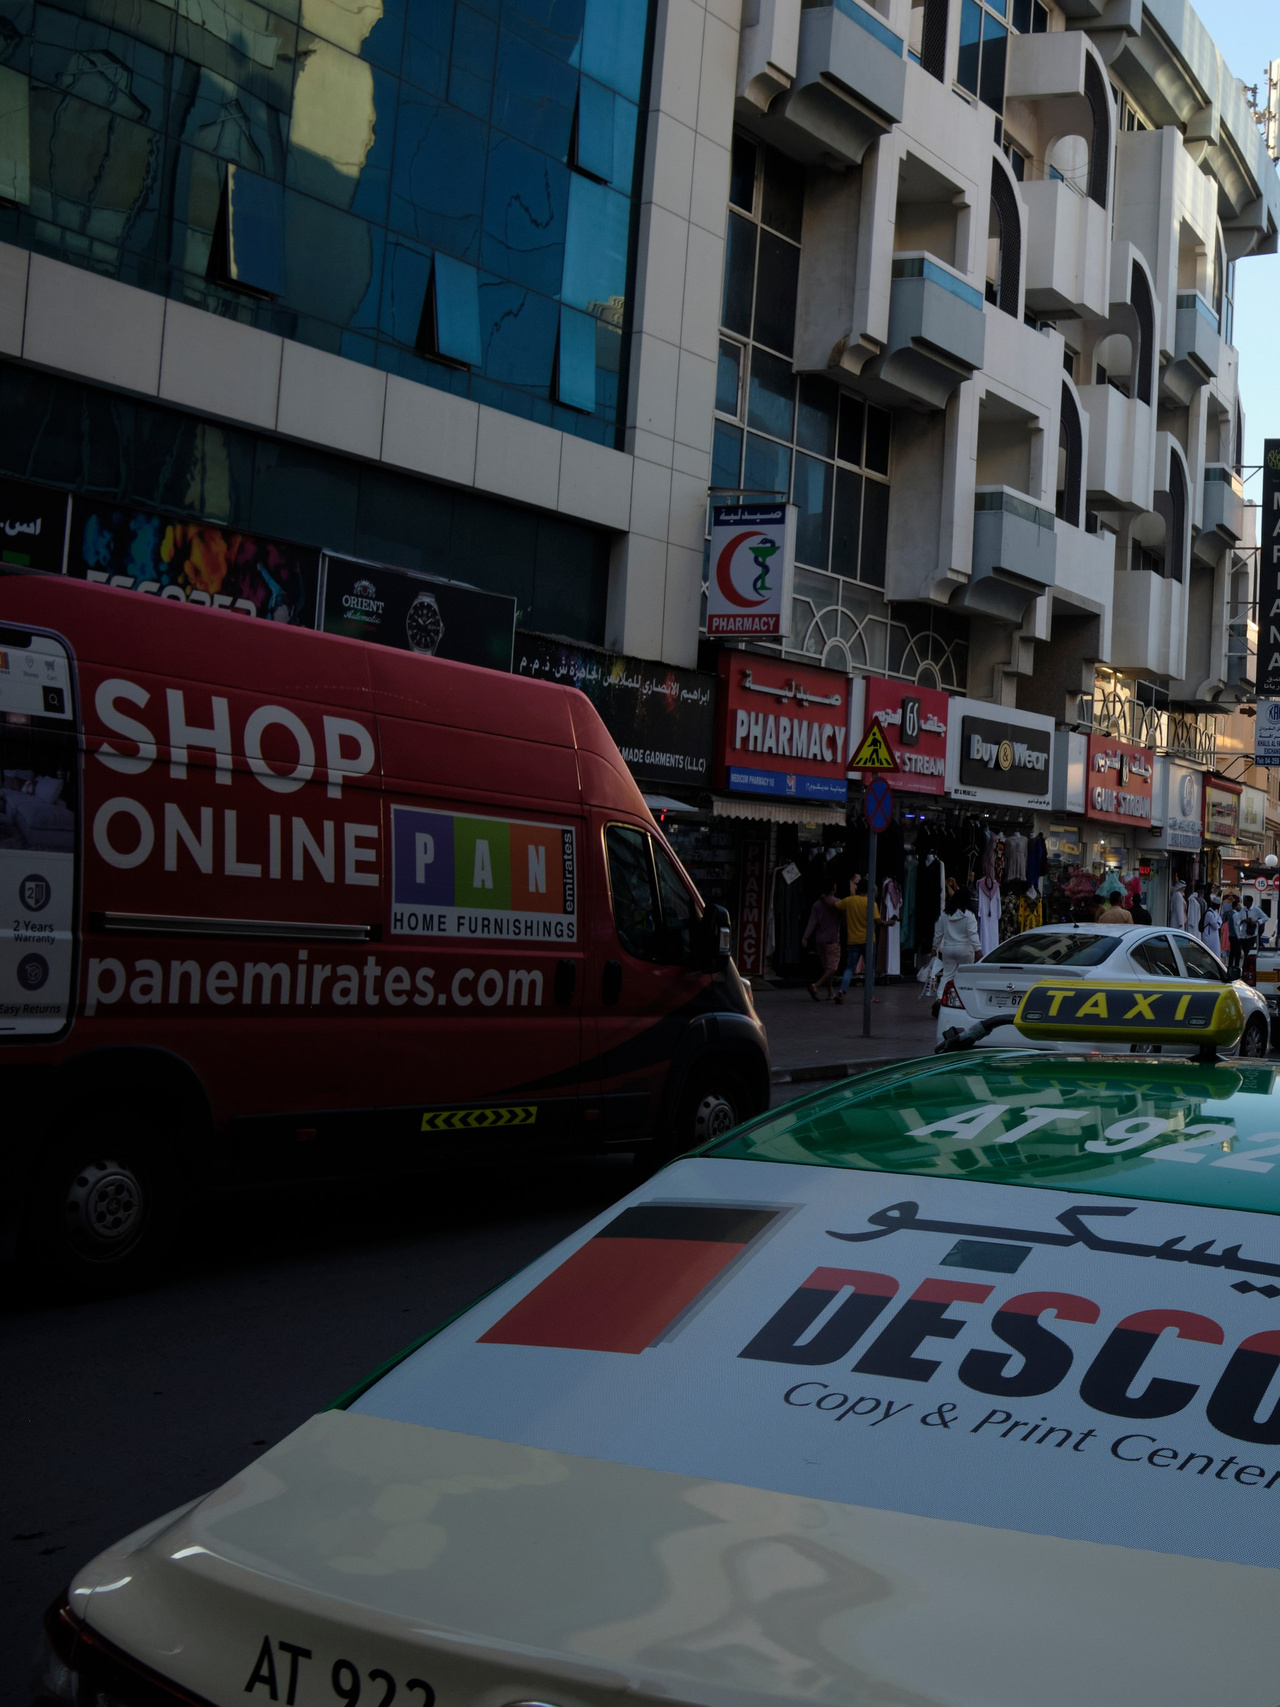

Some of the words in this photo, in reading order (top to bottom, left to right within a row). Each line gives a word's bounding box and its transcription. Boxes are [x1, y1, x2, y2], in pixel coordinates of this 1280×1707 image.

[719, 508, 783, 523] صيدلية
[342, 594, 385, 614] ORIENT
[712, 616, 776, 632] PHARMACY
[742, 669, 842, 708] صيدلية
[94, 678, 375, 800] SHOP
[734, 709, 846, 764] PHARMACY
[970, 734, 999, 768] Buy
[1013, 741, 1048, 771] Wear
[622, 747, 643, 763] MADE
[645, 750, 684, 769] GARMENTS
[903, 752, 945, 777] STREAM
[93, 797, 380, 887] ONLINE
[415, 832, 547, 893] PAN
[563, 833, 574, 913] emirates
[1257, 880, 1266, 888] 15
[394, 912, 447, 932] HOME
[457, 916, 575, 939] FURNISHINGS
[743, 846, 761, 969] PHARMACY
[13, 920, 21, 932] 2
[24, 920, 54, 934] Years
[14, 933, 56, 946] Warranty
[84, 949, 543, 1017] panemirates.com
[23, 1003, 61, 1014] Returns
[1045, 990, 1192, 1022] TAXI
[906, 1104, 1090, 1144] AT
[783, 1381, 911, 1428] Copy
[920, 1401, 959, 1430] &
[972, 1409, 1098, 1454] Print
[244, 1635, 312, 1706] AT
